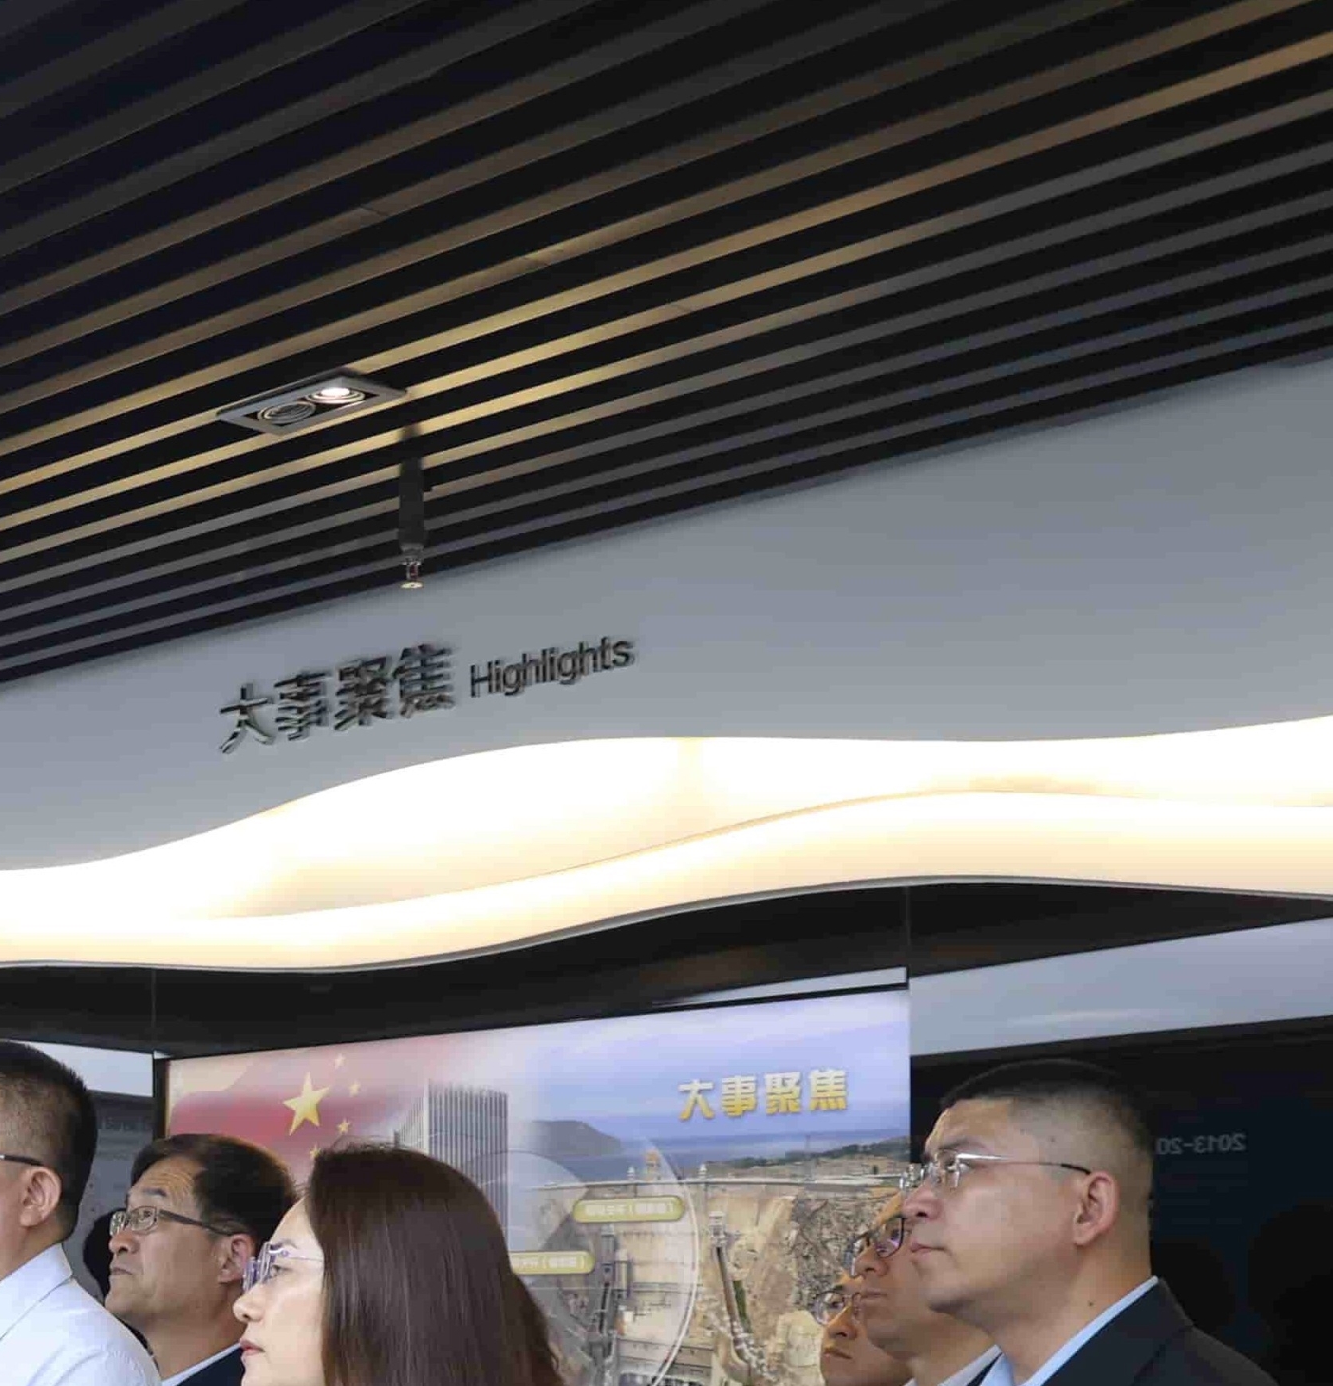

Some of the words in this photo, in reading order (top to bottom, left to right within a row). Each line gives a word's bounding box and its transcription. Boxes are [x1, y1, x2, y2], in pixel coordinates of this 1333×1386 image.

[218, 642, 455, 754] 大事聚焦
[470, 636, 635, 698] Highlights
[678, 1066, 849, 1122] 大事聚焦
